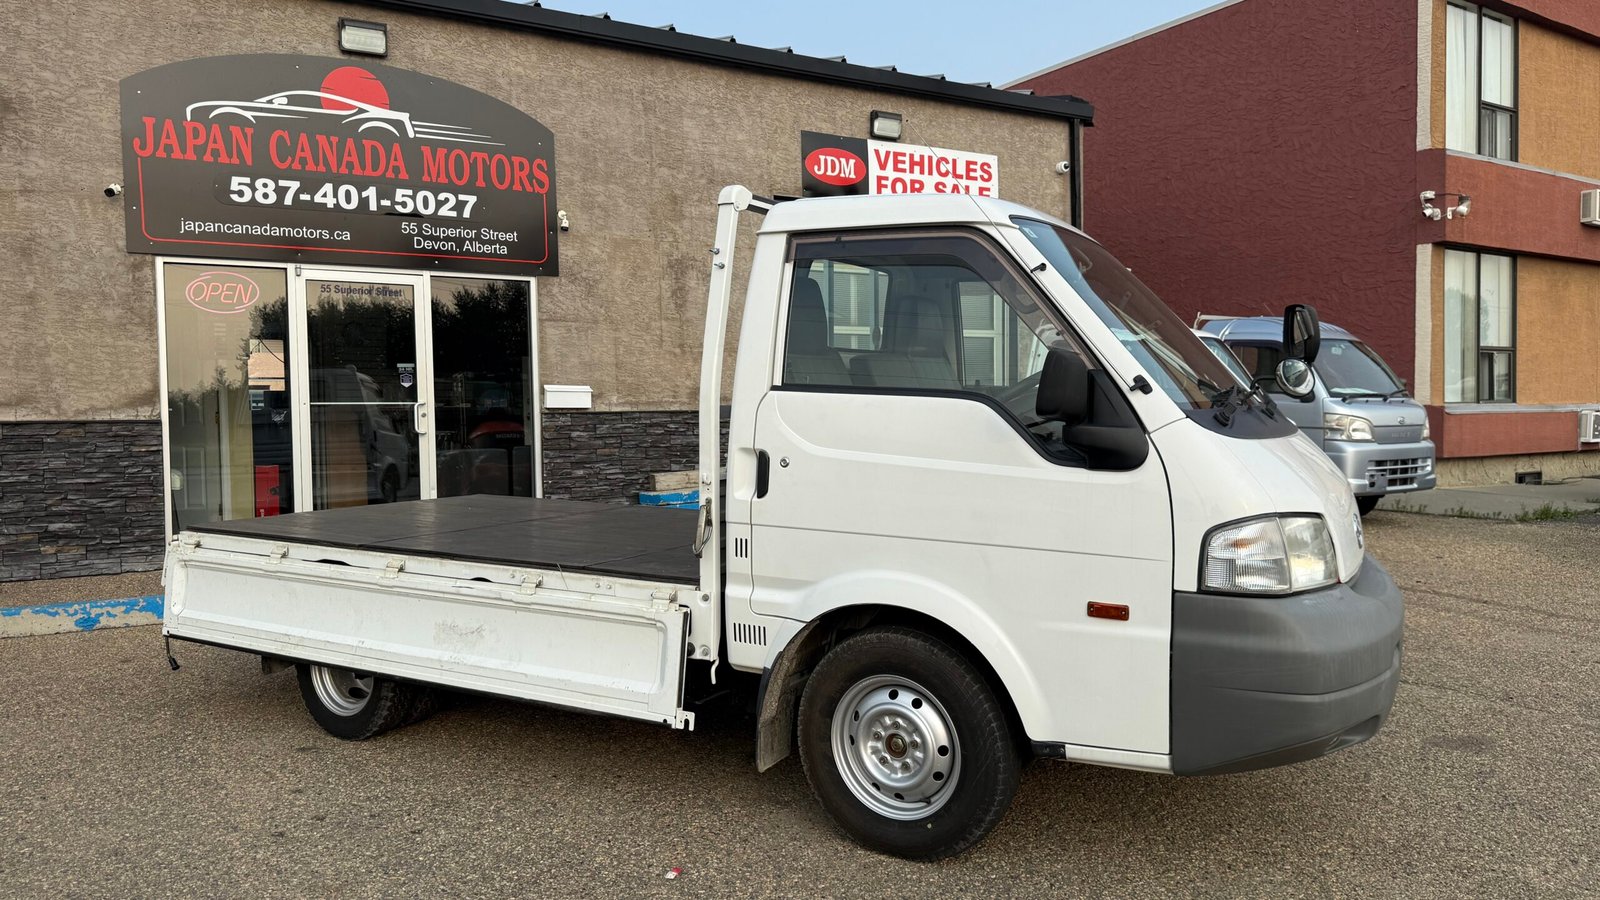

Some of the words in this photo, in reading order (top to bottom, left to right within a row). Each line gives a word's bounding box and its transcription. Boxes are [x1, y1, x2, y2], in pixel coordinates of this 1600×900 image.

[132, 116, 254, 167] JAPAN
[268, 129, 410, 181] CANADA
[421, 145, 550, 195] MOTORS
[813, 154, 857, 179] JDM
[873, 148, 993, 183] VEHICLES
[876, 175, 925, 194] FOR
[229, 175, 478, 219] 587-401-5027
[179, 217, 351, 242] japancanadamotors.ca
[401, 222, 418, 235] 55
[421, 223, 478, 240] Superior
[480, 227, 518, 242] Street
[413, 236, 461, 253] Devon,
[463, 239, 508, 255] Alberta
[190, 281, 253, 304] OPEN
[320, 283, 332, 293] 55
[334, 284, 374, 297] Superior
[375, 286, 402, 297] Street
